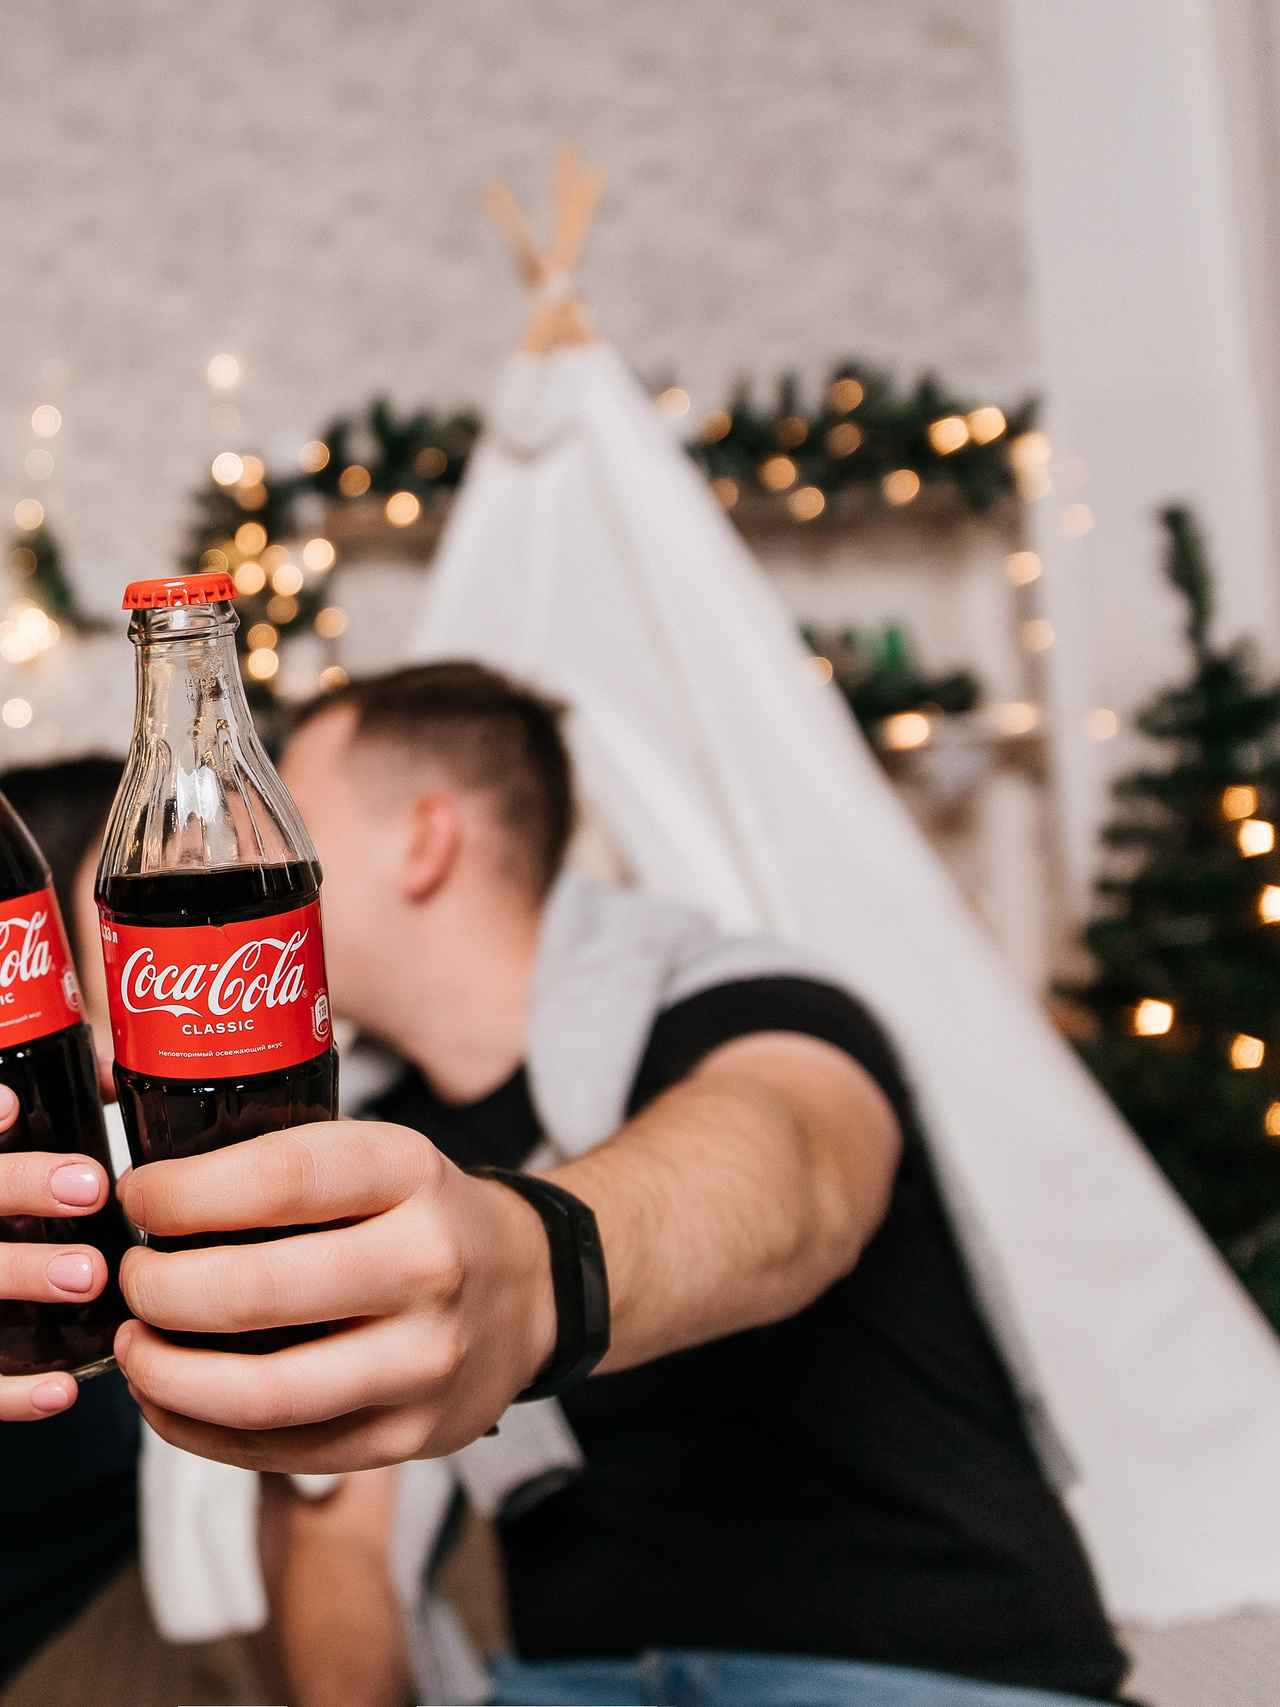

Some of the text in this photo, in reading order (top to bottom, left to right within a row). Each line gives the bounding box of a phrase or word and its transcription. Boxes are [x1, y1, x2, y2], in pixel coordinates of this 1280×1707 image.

[121, 927, 310, 1018] Coca-Cola
[181, 1019, 255, 1036] CLASSIC
[158, 1041, 283, 1059] Неповторимый освежающий вкус
